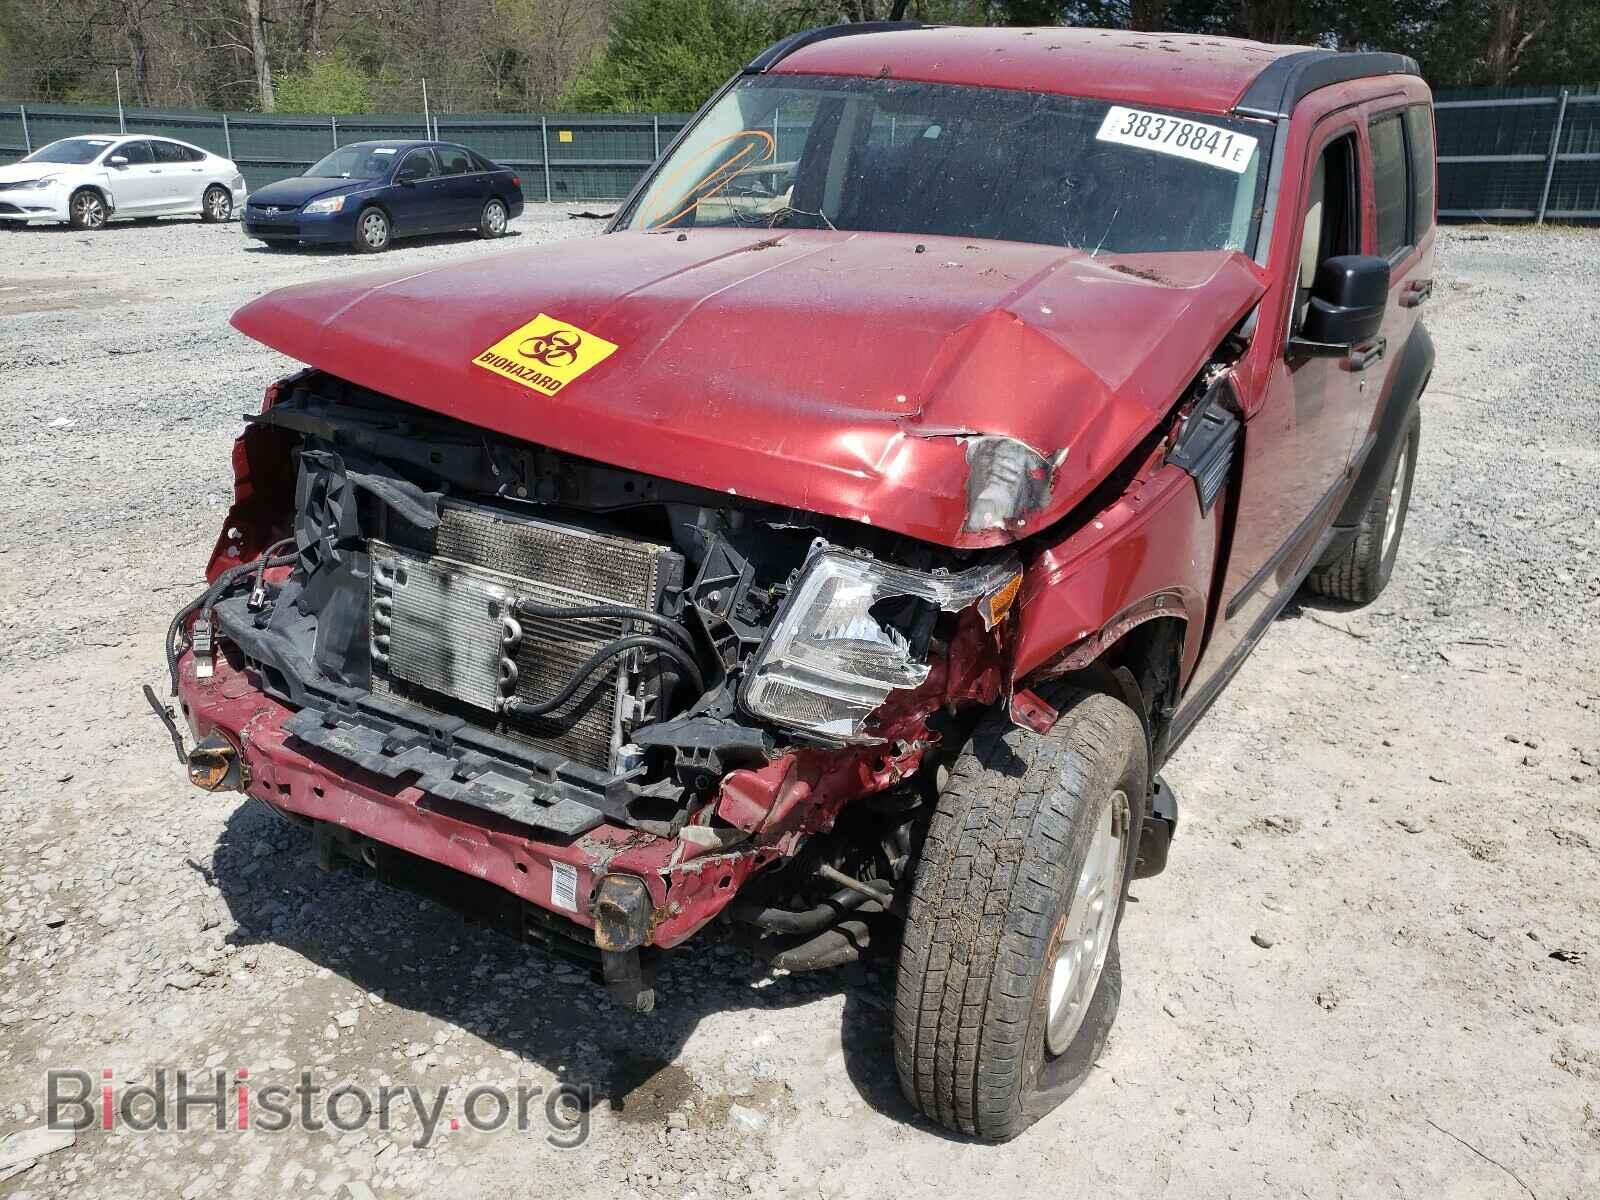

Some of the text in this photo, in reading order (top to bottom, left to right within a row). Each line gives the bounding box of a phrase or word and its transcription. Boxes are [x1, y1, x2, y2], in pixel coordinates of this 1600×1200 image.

[1120, 112, 1235, 158] 38378841
[1233, 148, 1244, 162] E
[479, 352, 562, 391] BIOHAZARD
